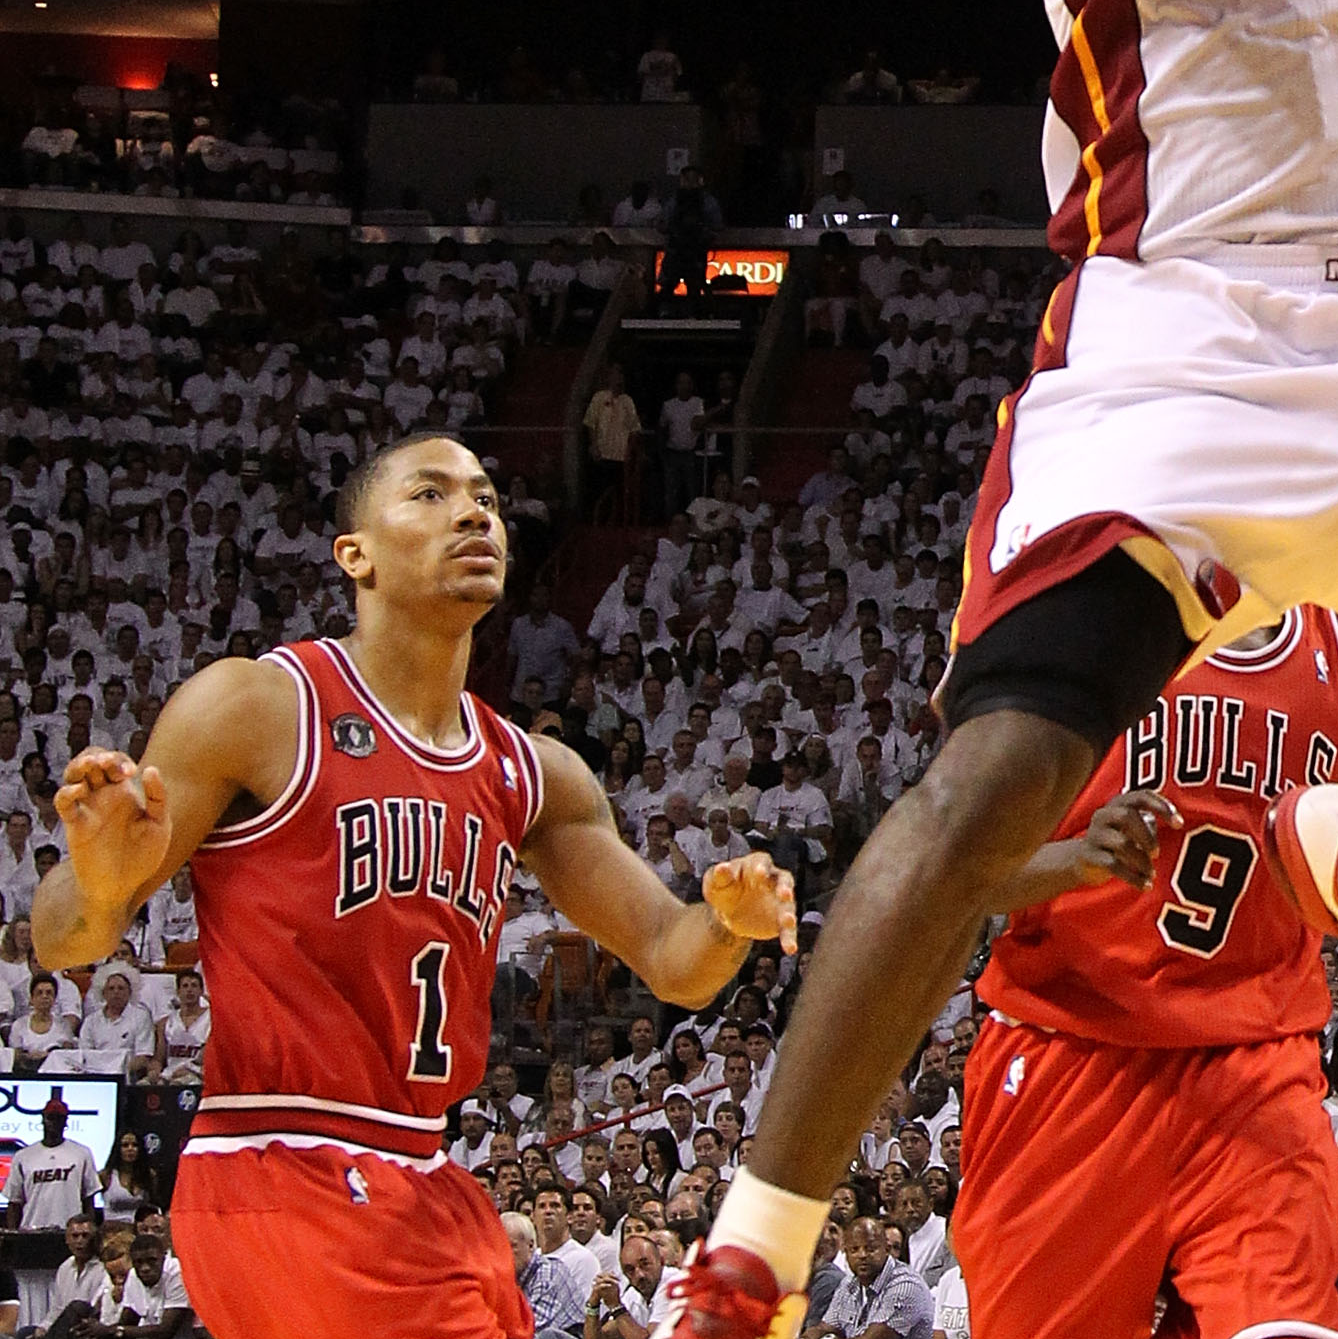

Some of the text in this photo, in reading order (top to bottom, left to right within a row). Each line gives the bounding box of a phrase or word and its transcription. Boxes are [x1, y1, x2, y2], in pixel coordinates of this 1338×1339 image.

[334, 796, 517, 955] BULLS
[1156, 823, 1260, 960] 9
[405, 940, 452, 1083] 1
[33, 1163, 76, 1184] HEAT
